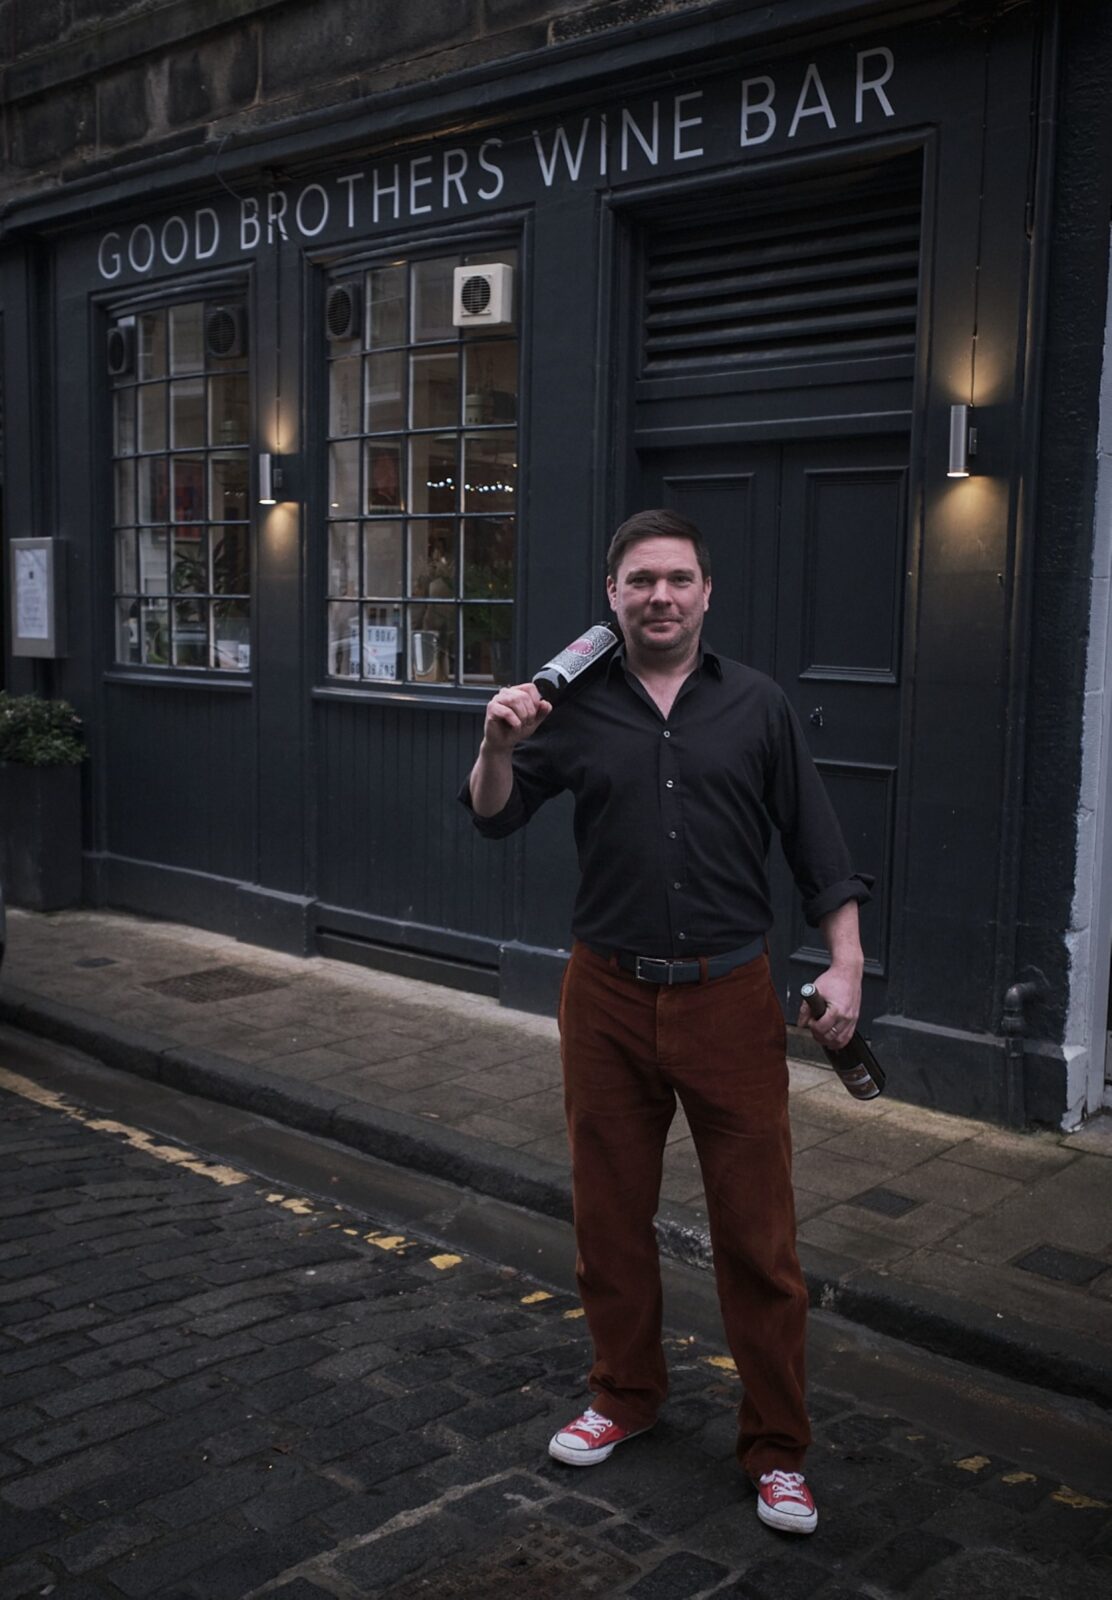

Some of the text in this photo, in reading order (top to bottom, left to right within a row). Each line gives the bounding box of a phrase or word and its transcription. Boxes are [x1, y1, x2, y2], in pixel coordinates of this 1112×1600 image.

[98, 46, 895, 280] GOOD BROTHERS WINE BAR
